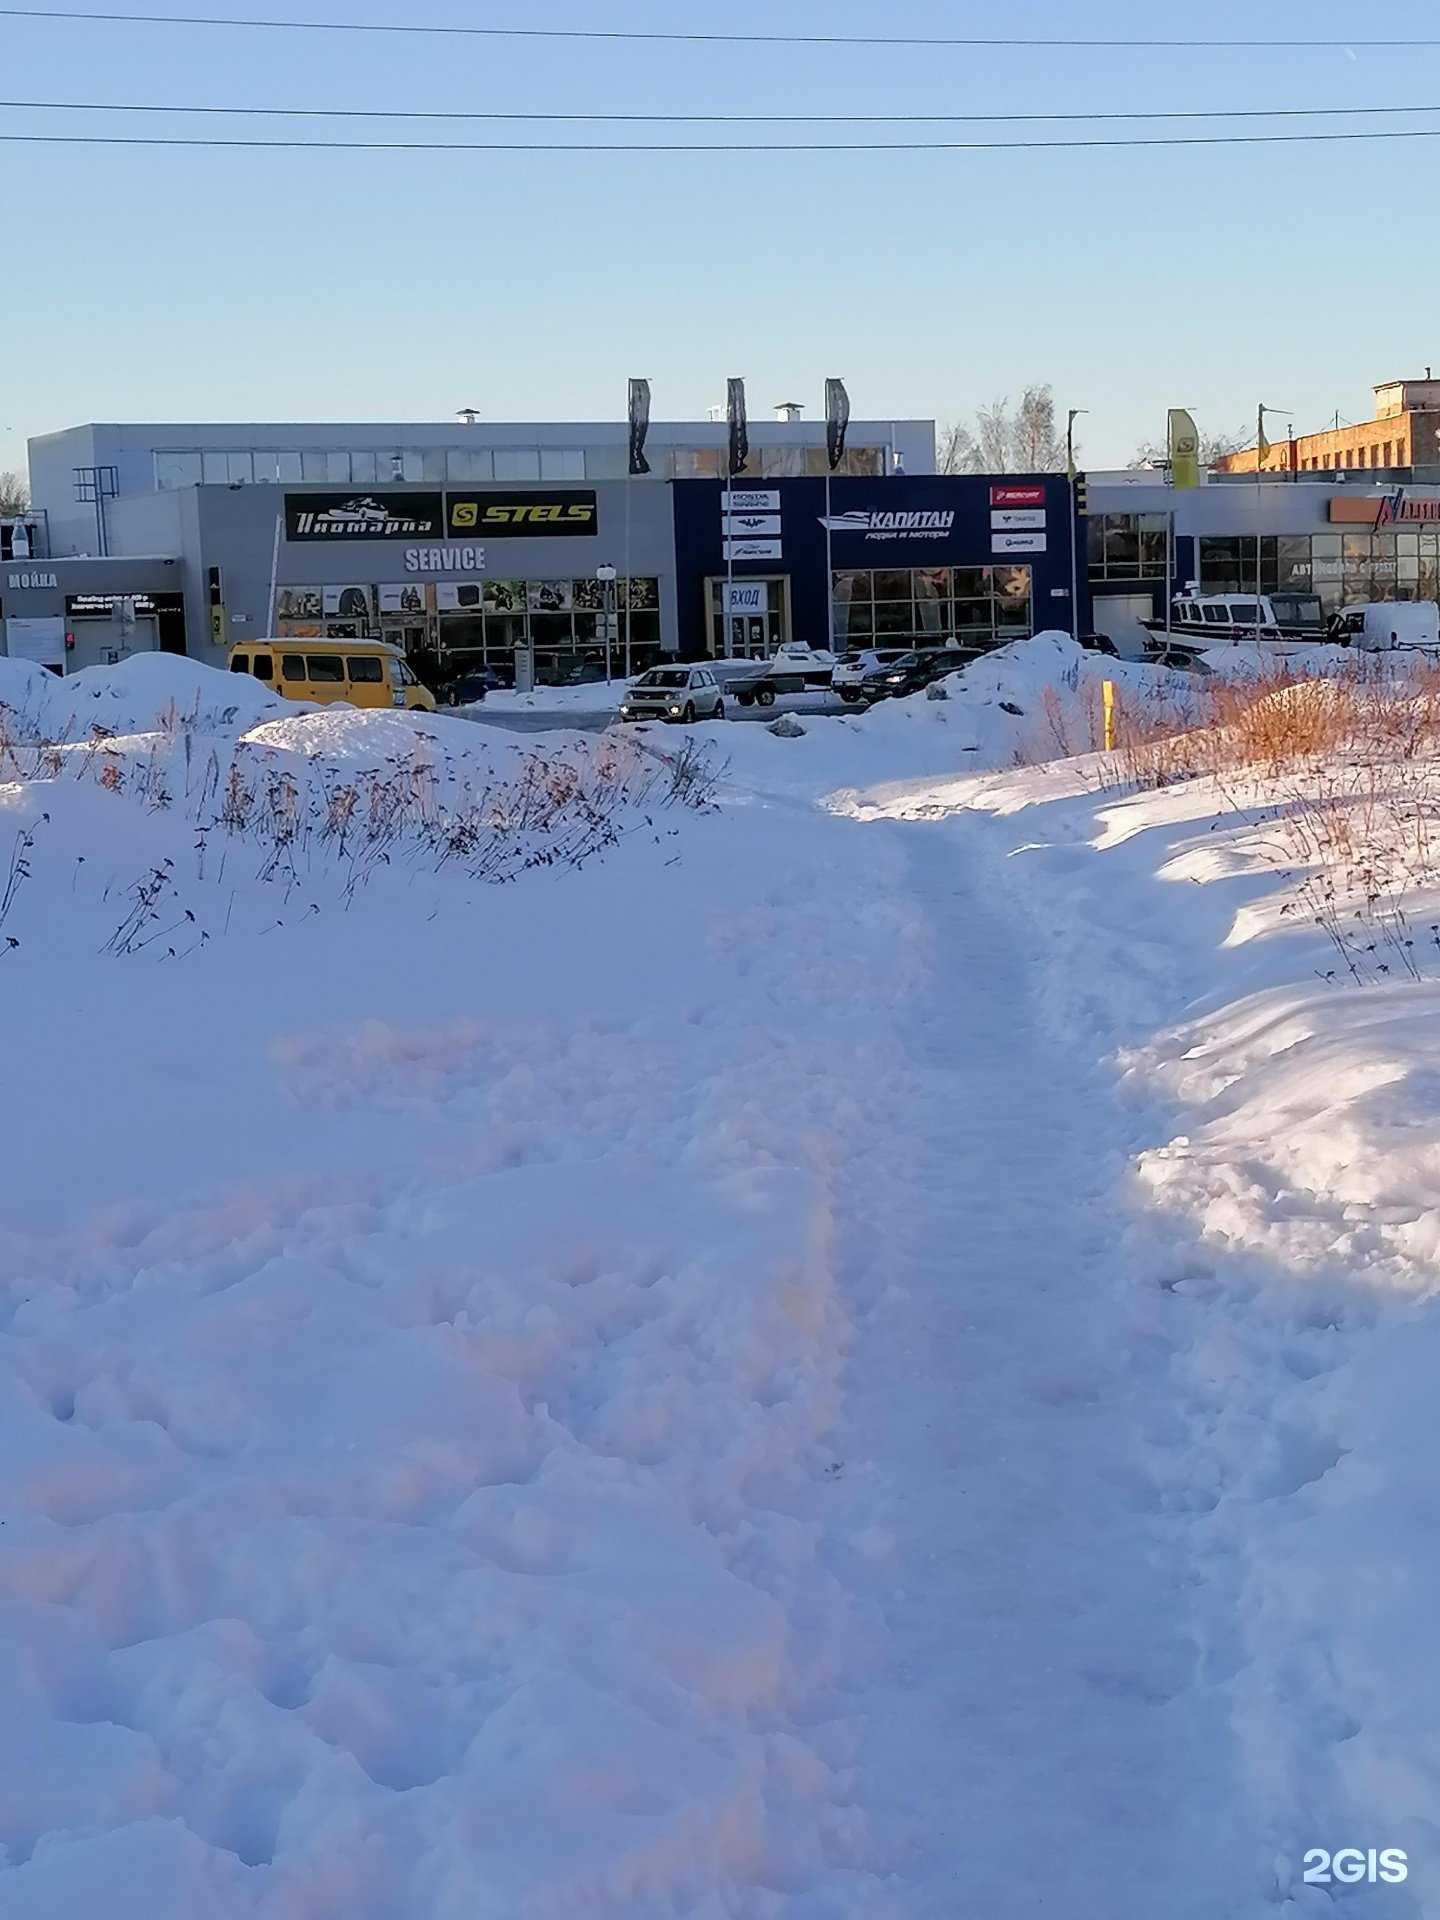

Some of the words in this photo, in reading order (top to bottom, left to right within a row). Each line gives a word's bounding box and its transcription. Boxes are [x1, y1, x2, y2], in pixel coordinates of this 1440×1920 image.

[481, 505, 595, 523] STELS
[869, 511, 955, 529] КАПИТАН
[405, 547, 486, 571] SERVICE
[730, 589, 761, 606] ВХОД
